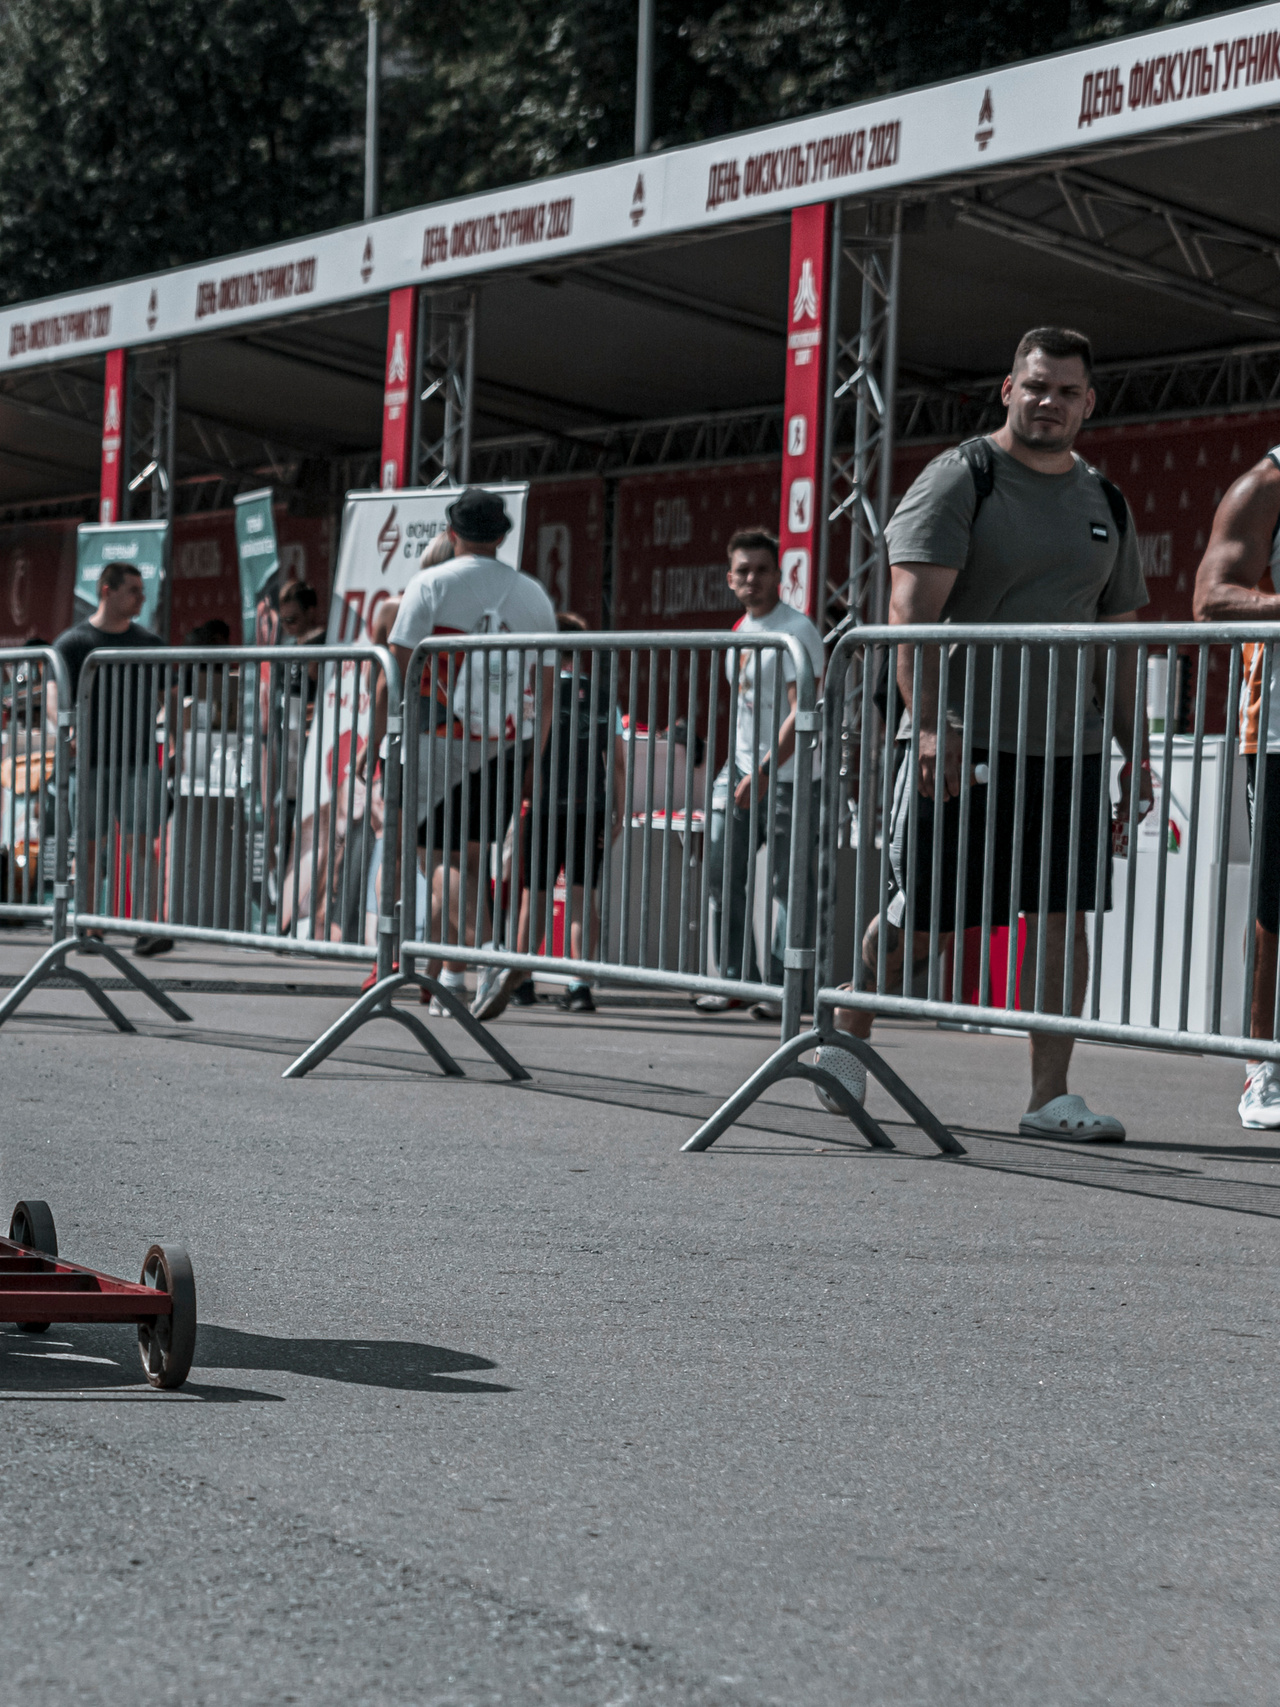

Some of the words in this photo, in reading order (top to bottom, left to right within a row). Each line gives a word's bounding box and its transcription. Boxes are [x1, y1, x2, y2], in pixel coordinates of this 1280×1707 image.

[1078, 65, 1124, 129] ДЕНЬ
[706, 158, 740, 212] ДЕНЬ
[742, 128, 867, 198] ФИЗКУЛЬТУРНИКА
[867, 118, 902, 171] 2021
